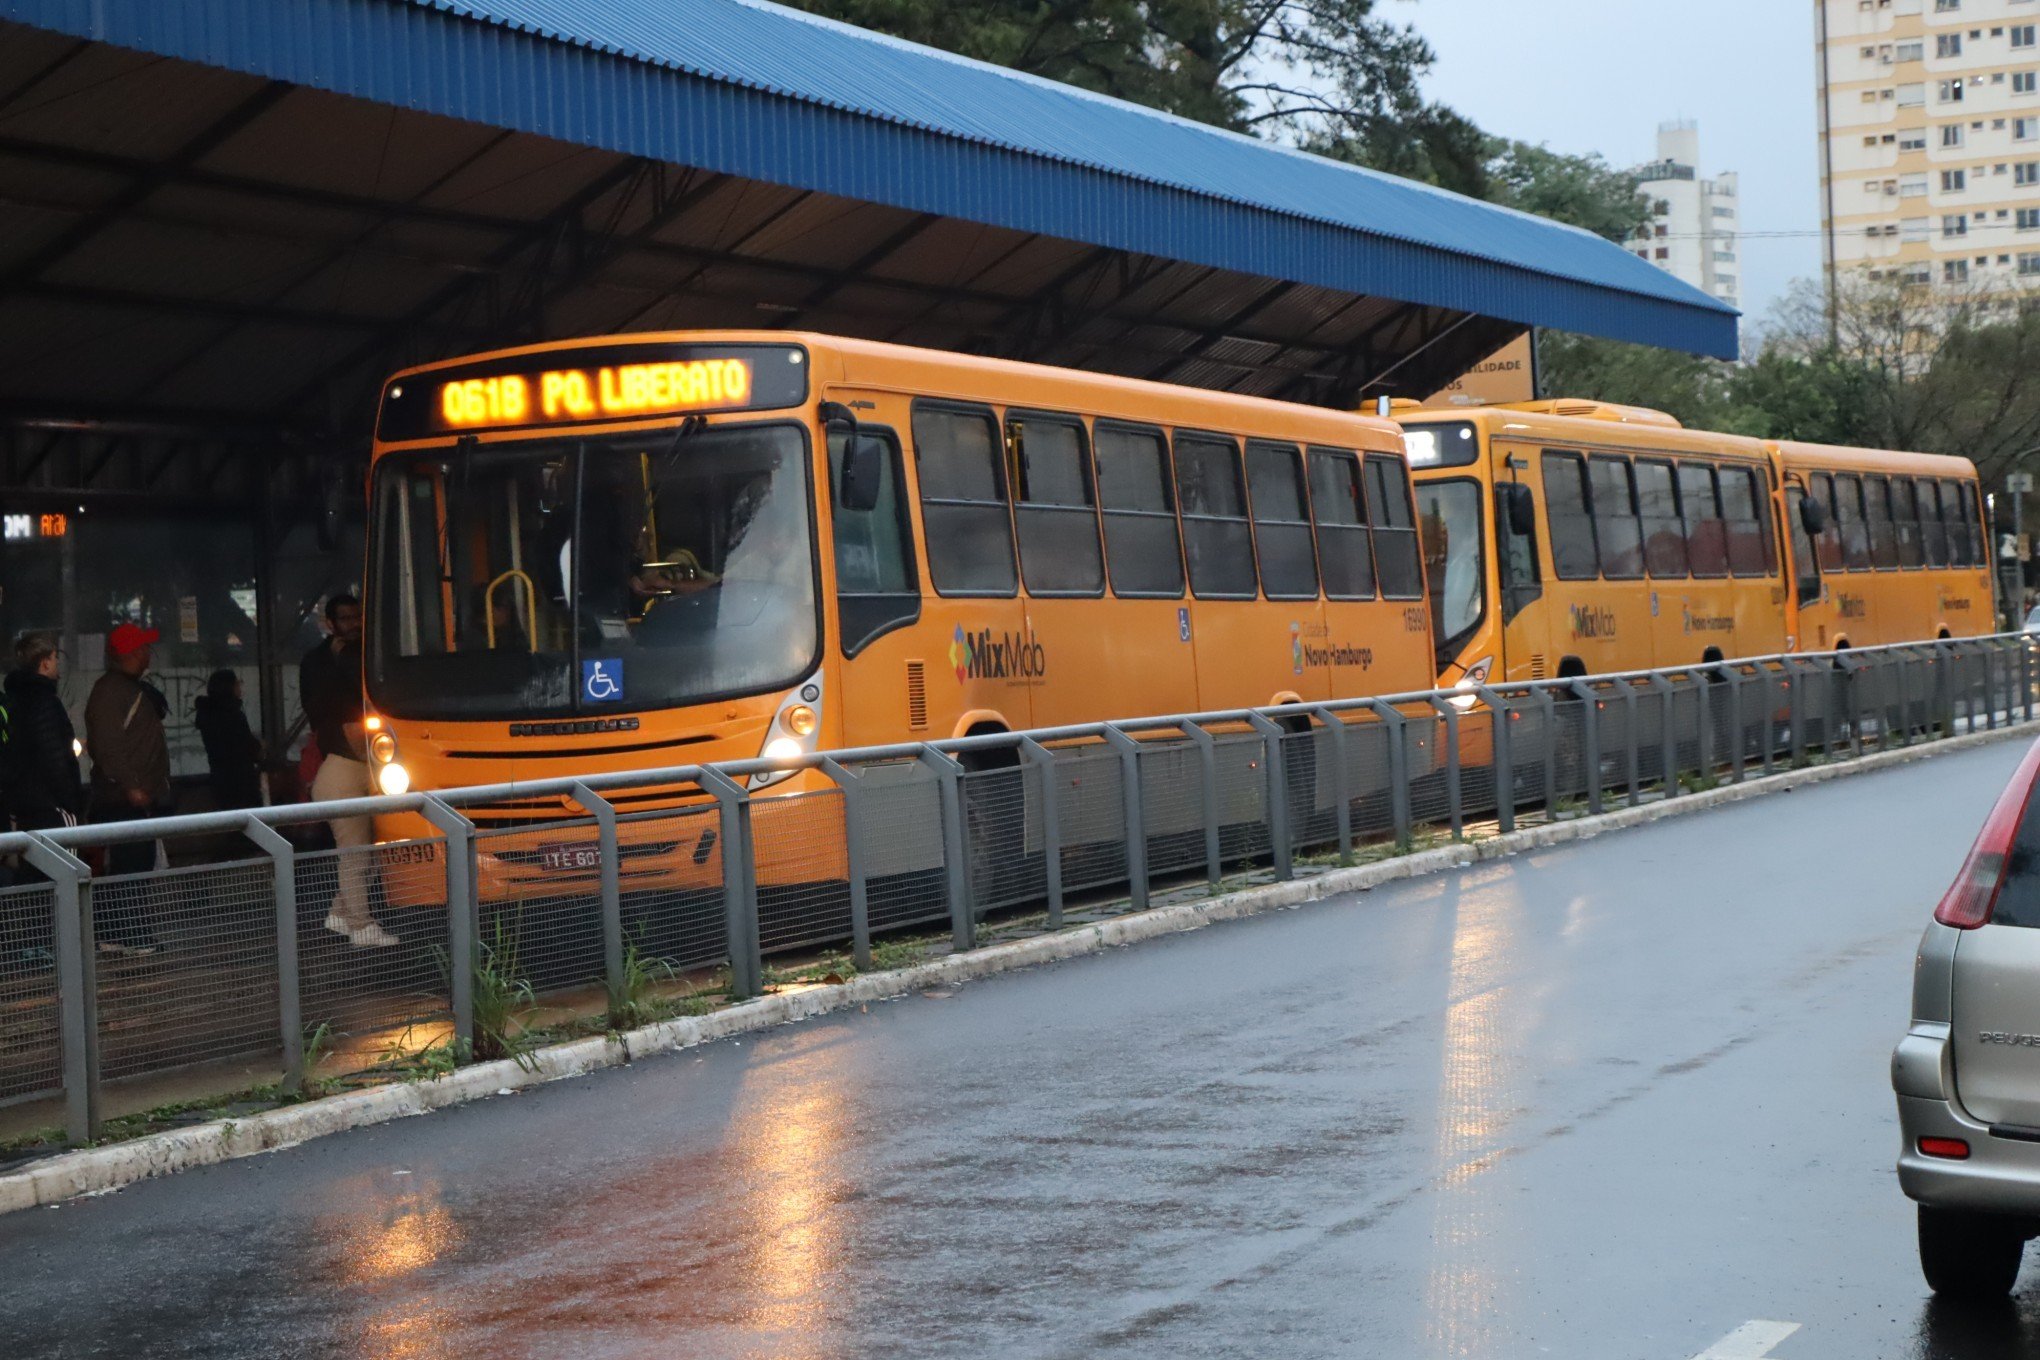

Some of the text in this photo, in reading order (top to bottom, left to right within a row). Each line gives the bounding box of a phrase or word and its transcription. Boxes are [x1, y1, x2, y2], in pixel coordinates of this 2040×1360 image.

[599, 357, 748, 411] LIBERATO
[966, 627, 1045, 679] MixMob
[1304, 641, 1373, 671] Novo Hamburgo
[509, 717, 639, 737] NEOBUS
